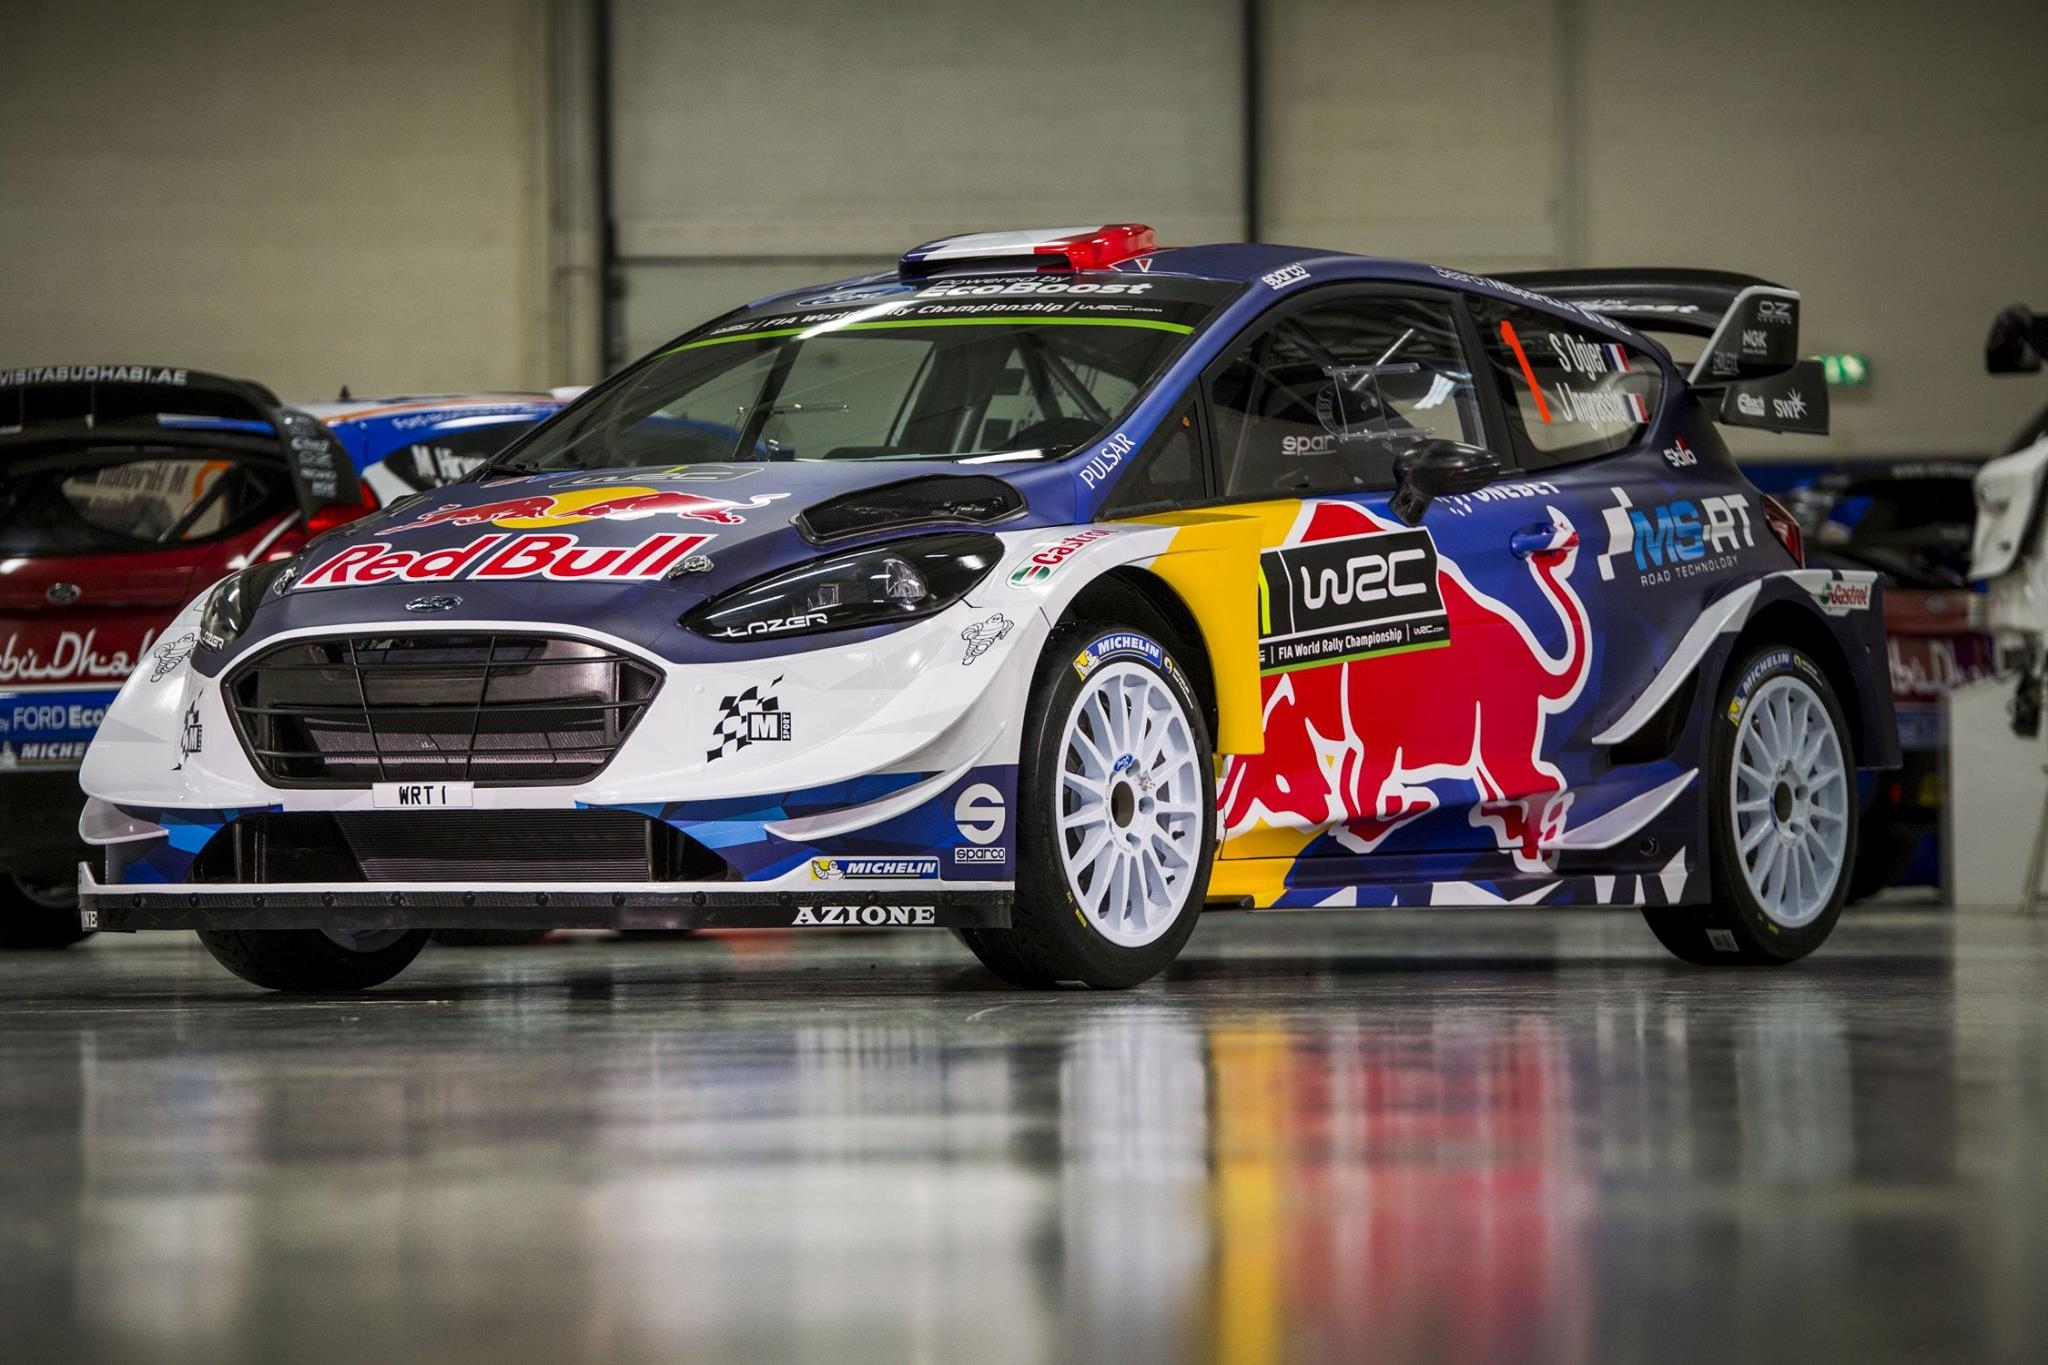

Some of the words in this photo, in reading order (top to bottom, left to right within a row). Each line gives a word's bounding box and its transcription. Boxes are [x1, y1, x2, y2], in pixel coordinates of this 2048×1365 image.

[915, 282, 1153, 298] EcoBoost
[1039, 275, 1071, 284] by
[762, 316, 798, 328] FIA
[800, 309, 862, 323] Worl
[917, 302, 1064, 314] Championship
[1742, 329, 1767, 349] NGK
[1549, 333, 1571, 373] S
[1564, 333, 1608, 382] Ogier
[0, 366, 188, 386] VISITABUDHABI.AE
[1079, 432, 1136, 490] PULSAR
[1031, 529, 1119, 565] Castrol
[293, 533, 502, 588] Red
[468, 533, 719, 583] Bull
[1640, 570, 1671, 587] ROAD
[1675, 554, 1739, 578] TECHNOLOGY
[1300, 548, 1428, 610] WRC
[1828, 583, 1869, 606] Castrol
[0, 632, 48, 680] bu
[1097, 634, 1161, 658] MICHELIN
[1279, 646, 1295, 660] FIA
[1294, 641, 1320, 657] World
[1321, 637, 1345, 653] Rally
[1345, 628, 1403, 648] Championship
[1742, 652, 1790, 695] MICHELIN
[13, 706, 66, 731] FORD
[68, 705, 112, 728] Eco
[781, 713, 791, 740] SPORT
[398, 785, 434, 805] WRT
[845, 862, 937, 874] MICHELIN
[956, 849, 1005, 863] sparco
[791, 906, 936, 925] AZIONE
